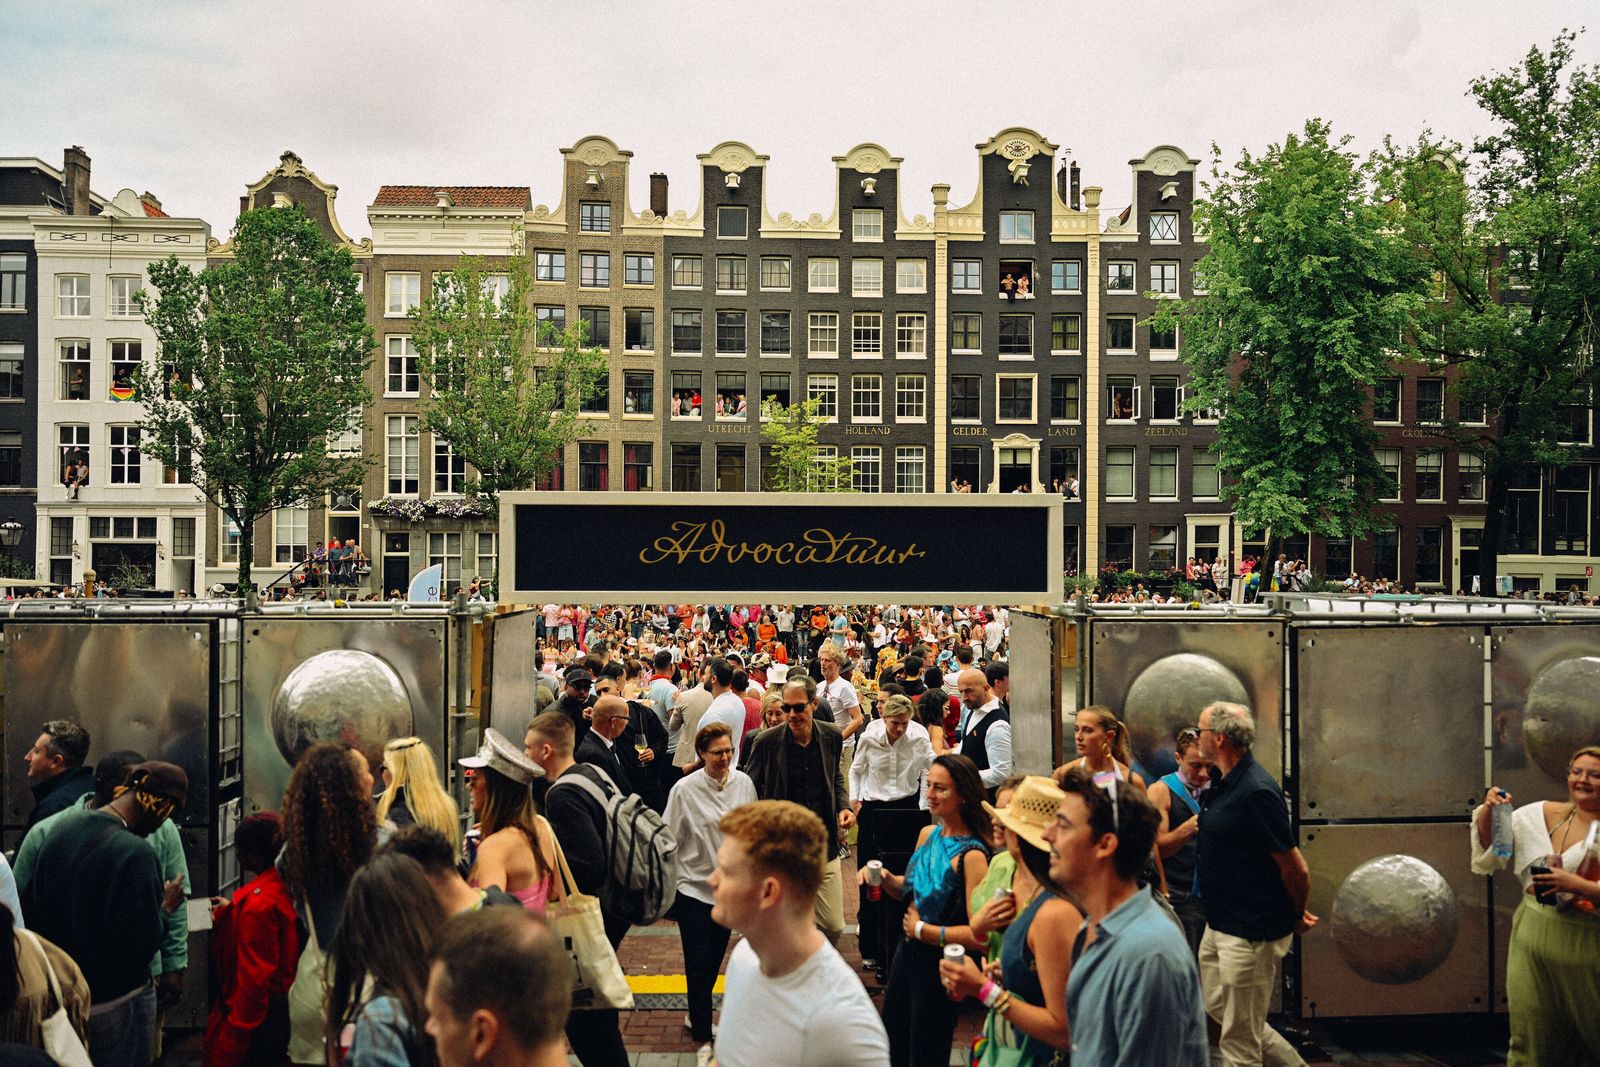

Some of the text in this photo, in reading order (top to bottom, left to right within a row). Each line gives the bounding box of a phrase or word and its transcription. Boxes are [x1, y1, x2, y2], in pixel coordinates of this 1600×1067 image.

[708, 424, 752, 434] UTRECHT
[845, 425, 891, 435] HOLLAND
[953, 427, 1077, 437] GELDER LAND
[1144, 427, 1188, 436] ZEELAND
[639, 519, 926, 565] Advocatuur
